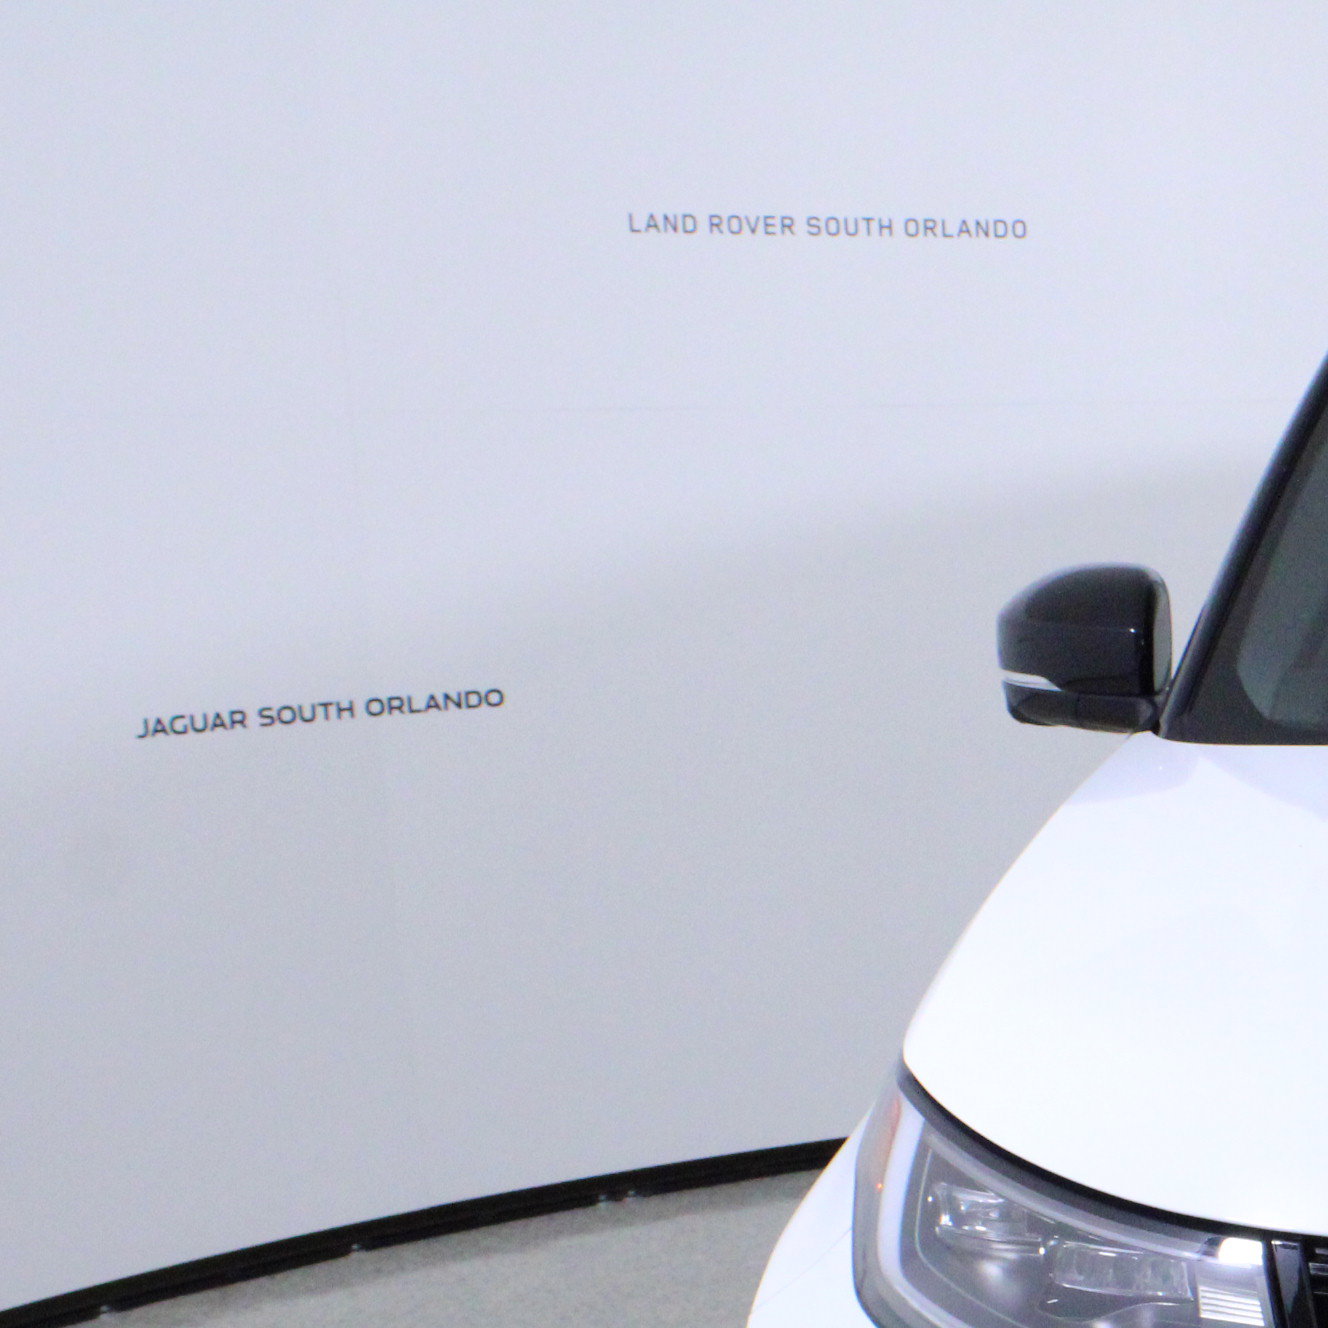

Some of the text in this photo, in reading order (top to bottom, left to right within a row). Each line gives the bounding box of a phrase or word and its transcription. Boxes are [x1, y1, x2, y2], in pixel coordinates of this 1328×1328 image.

[627, 212, 1028, 240] LAND ROVER SOUTH ORLANDO
[135, 687, 506, 741] JAGUAR SOUTH ORLANDO
